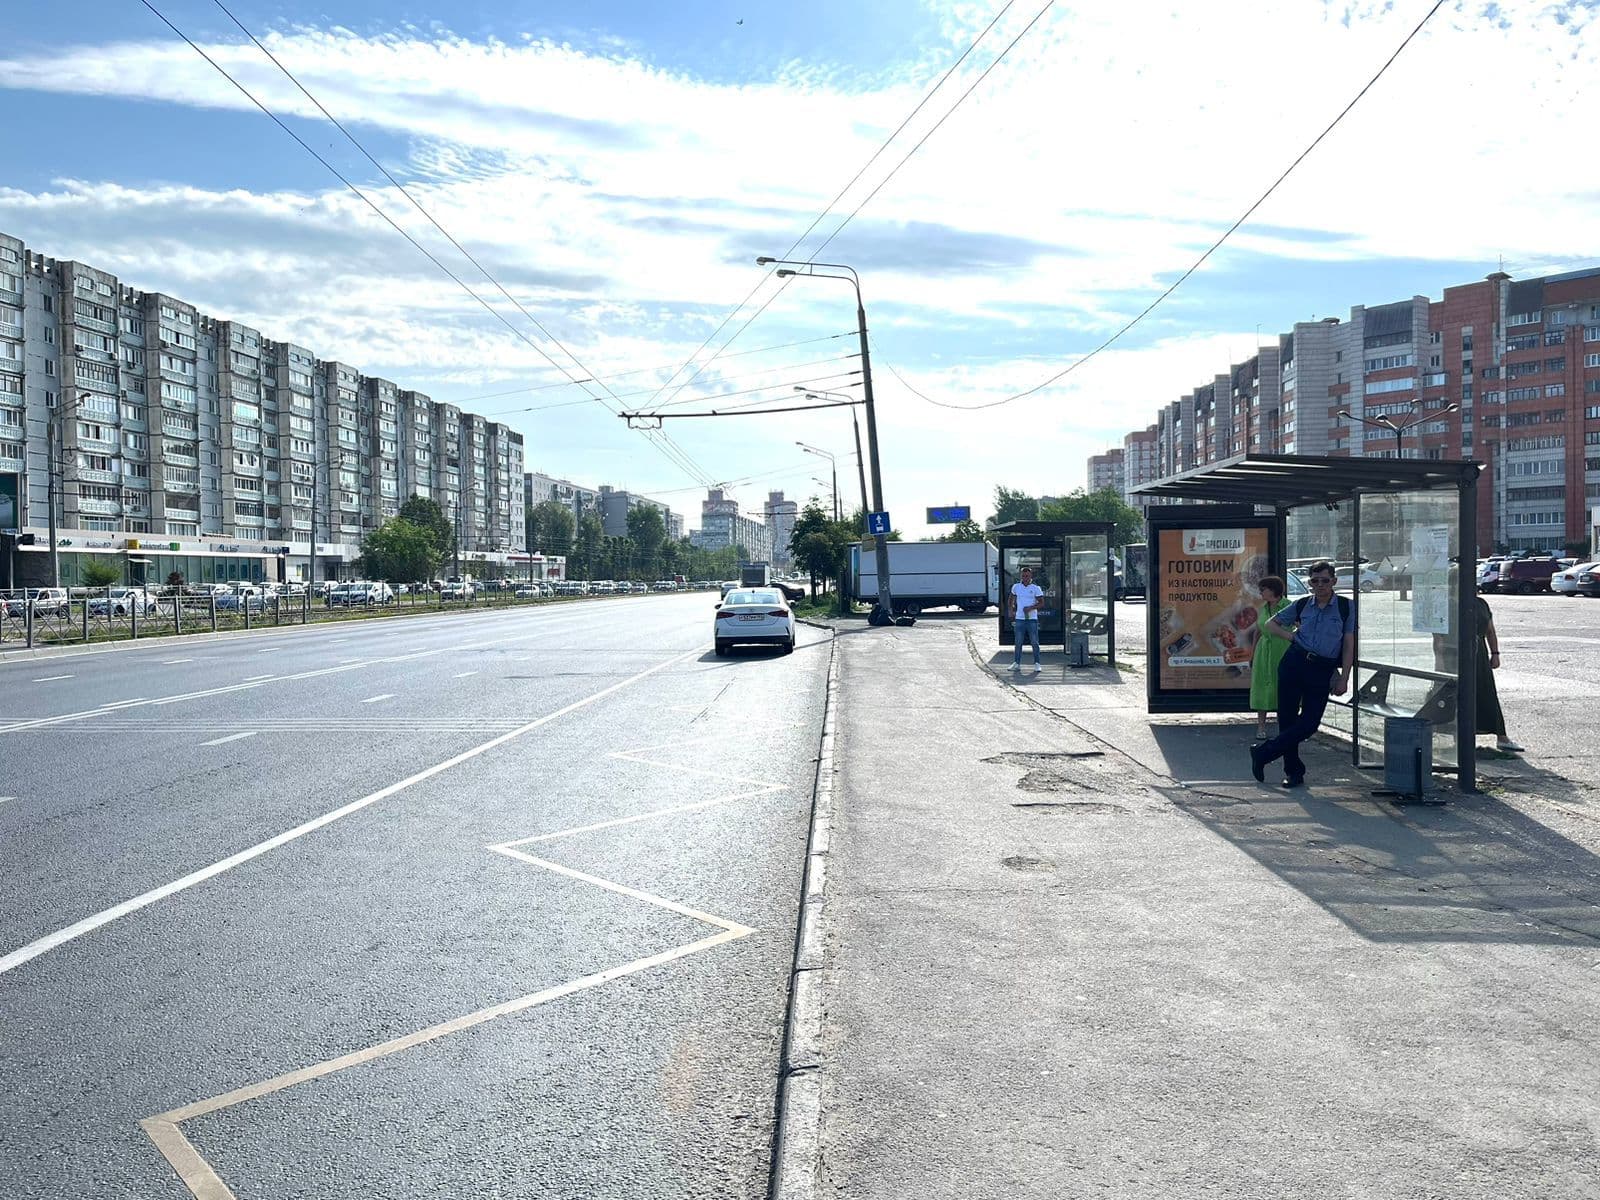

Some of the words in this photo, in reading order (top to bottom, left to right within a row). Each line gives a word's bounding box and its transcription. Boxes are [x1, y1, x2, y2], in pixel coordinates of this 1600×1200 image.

[1168, 560, 1234, 573] ГОТОВИМ
[1168, 579, 1180, 588] ИЗ
[1168, 593, 1218, 602] ПРОДУКТОВ
